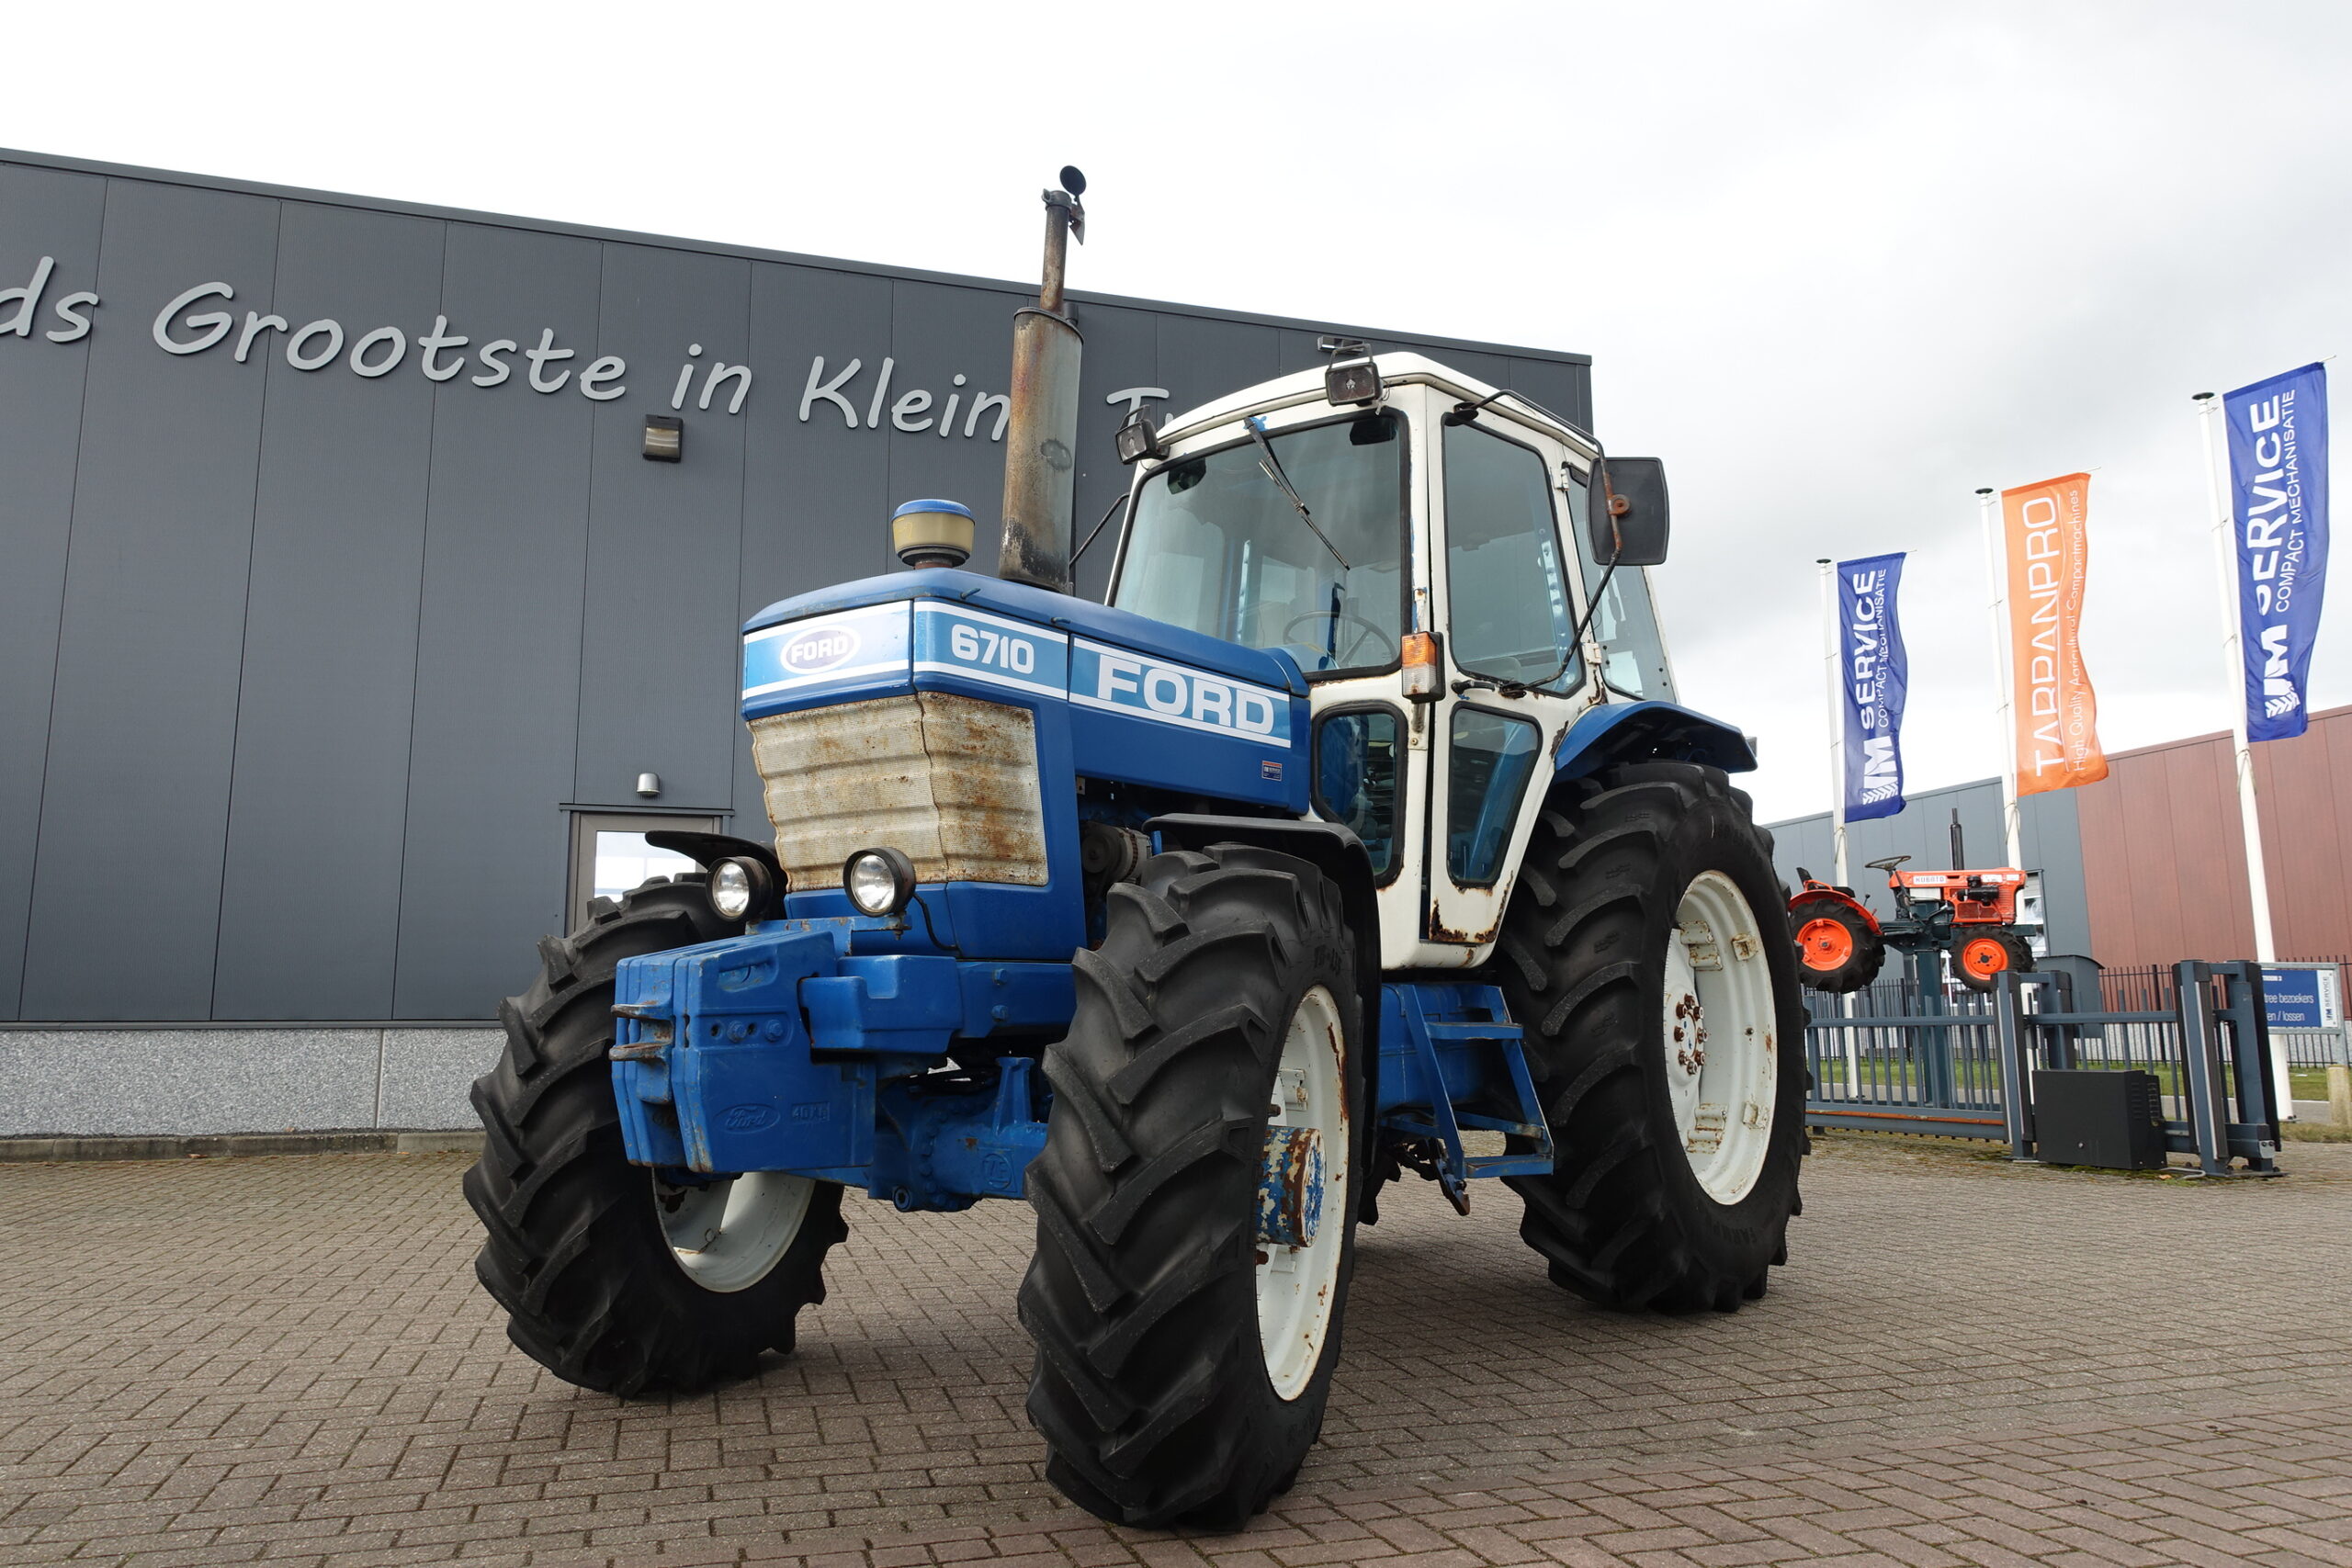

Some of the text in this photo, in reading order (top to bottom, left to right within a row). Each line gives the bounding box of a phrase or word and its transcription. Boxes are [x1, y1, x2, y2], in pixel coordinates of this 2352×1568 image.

[153, 281, 627, 401] Grootste
[671, 344, 752, 415] in
[798, 355, 1010, 442] Klein
[2276, 389, 2304, 613] COMPACT MECHANISATIE
[791, 636, 848, 664] FORD
[951, 624, 1035, 674] 6710
[1852, 570, 1879, 730] SERVICE
[2022, 496, 2064, 777] TARPANPRO
[1097, 653, 1274, 735] FORD
[2068, 691, 2086, 736] Quality
[2070, 739, 2086, 772] High
[2278, 993, 2314, 1004] bezoekers
[2282, 1011, 2305, 1021] lossen
